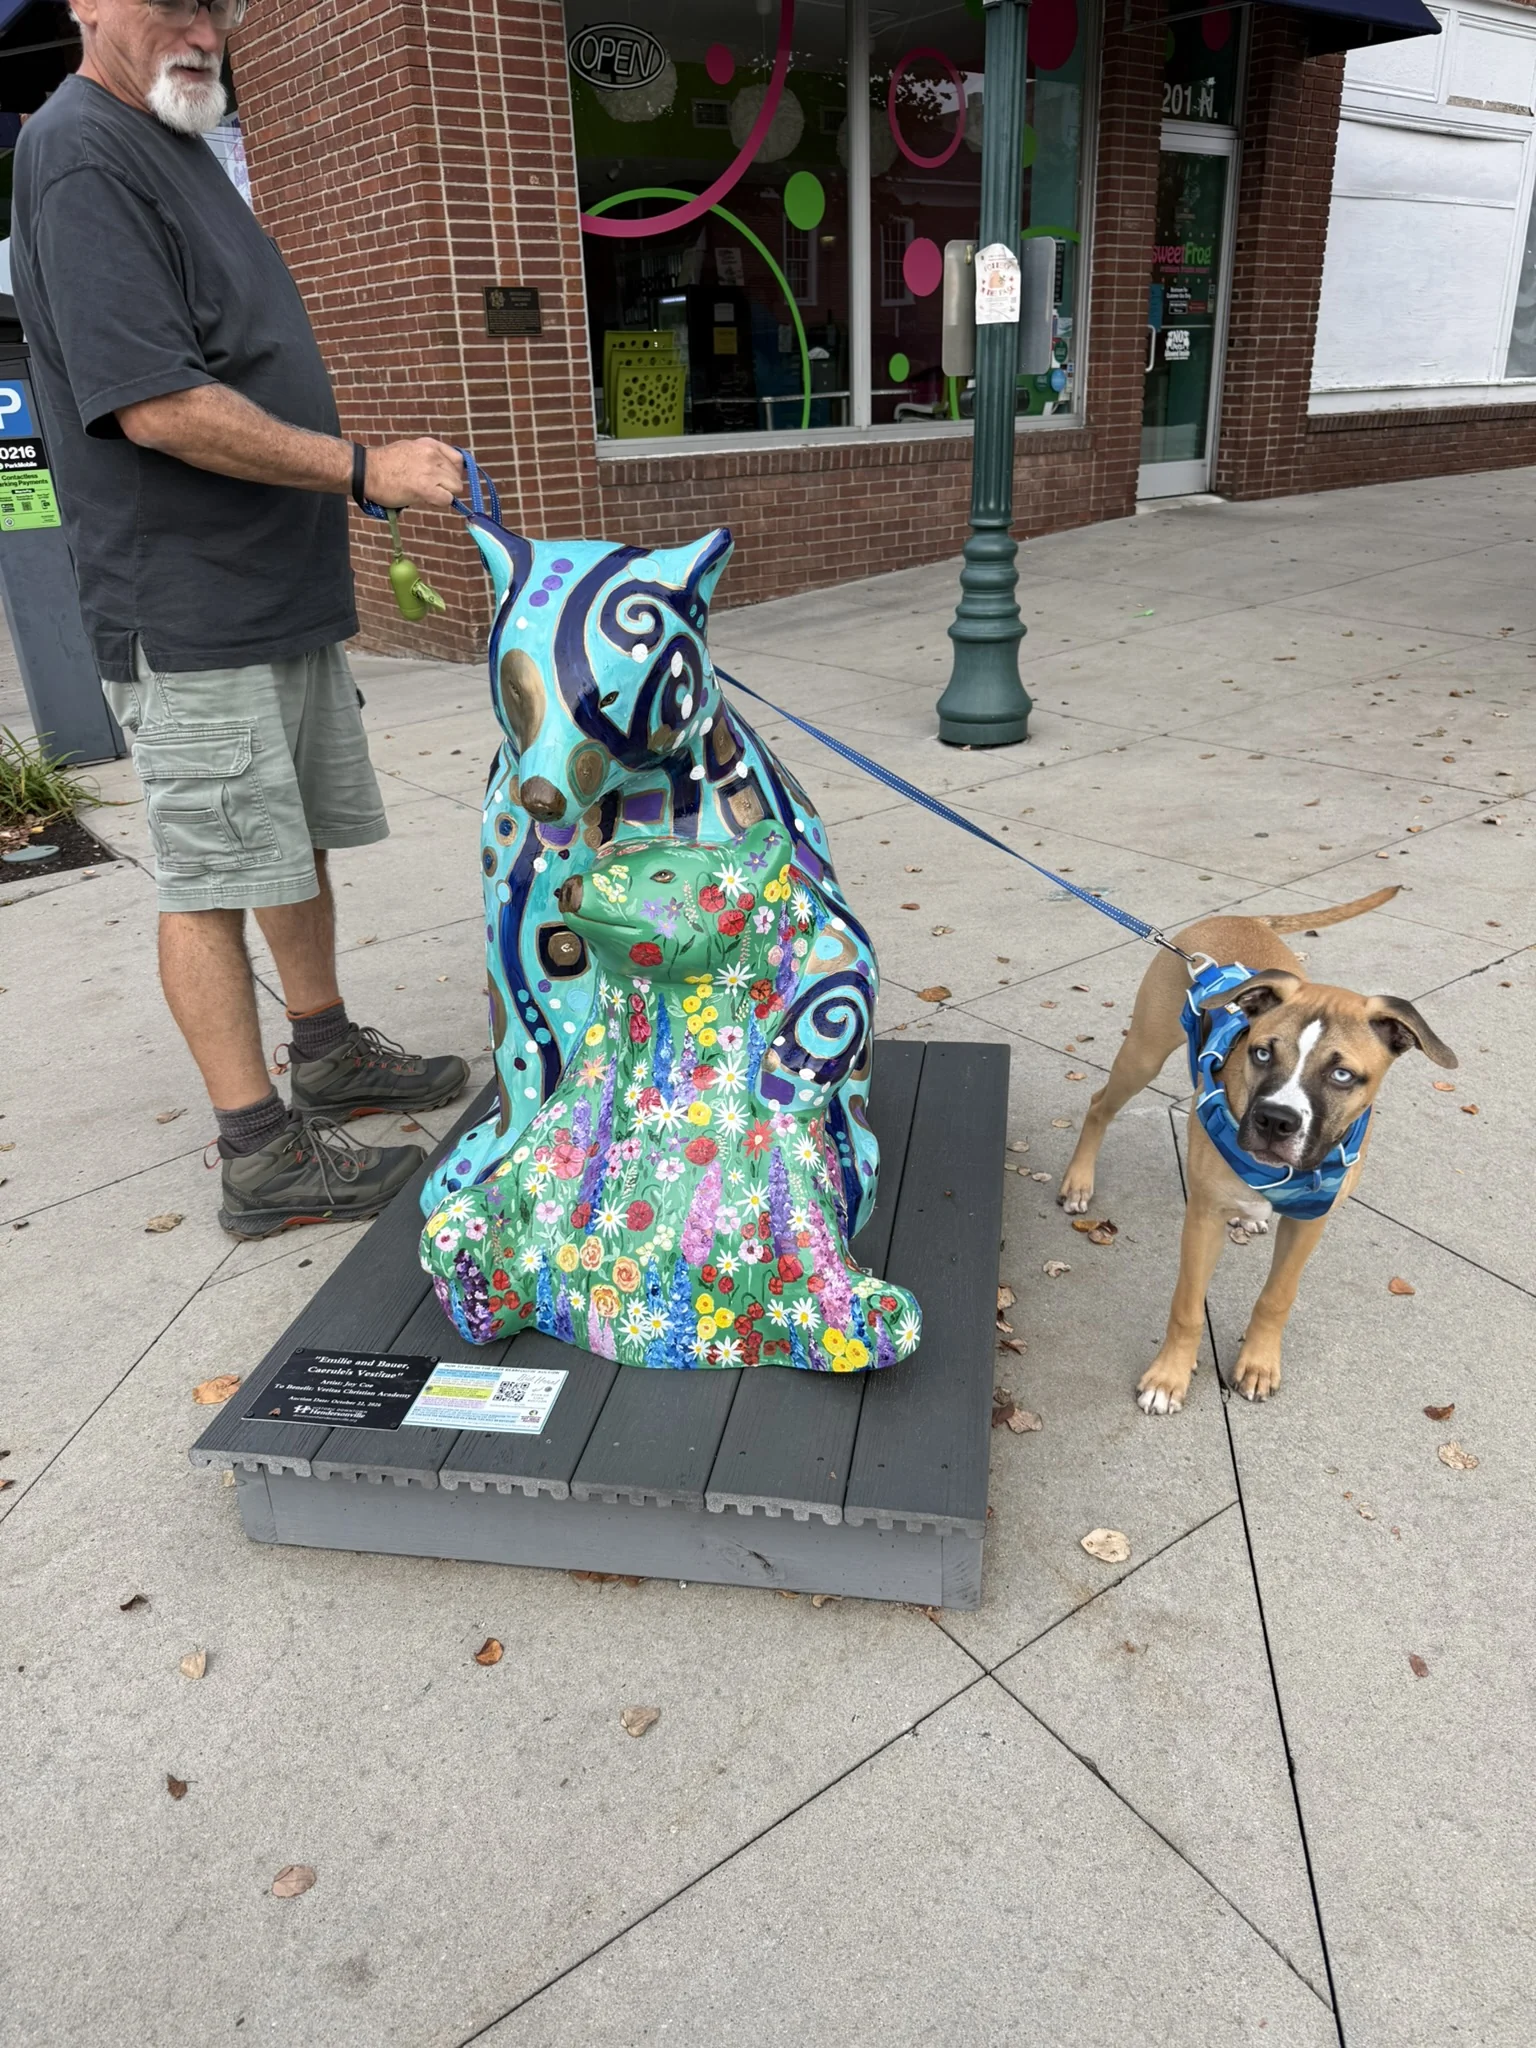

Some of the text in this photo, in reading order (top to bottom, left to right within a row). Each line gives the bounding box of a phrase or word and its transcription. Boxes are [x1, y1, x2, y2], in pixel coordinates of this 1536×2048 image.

[580, 35, 655, 78] OPEN
[1162, 82, 1192, 116] 201
[1152, 242, 1212, 265] sweetFrog
[0, 388, 22, 430] P
[4, 461, 38, 469] ParkMobile
[315, 1355, 410, 1370] "Emilie and Bauer,
[286, 1384, 314, 1392] Benefit:
[343, 1388, 376, 1397] Christian
[377, 1391, 412, 1399] Academy
[309, 1409, 366, 1419] Hendersonville
